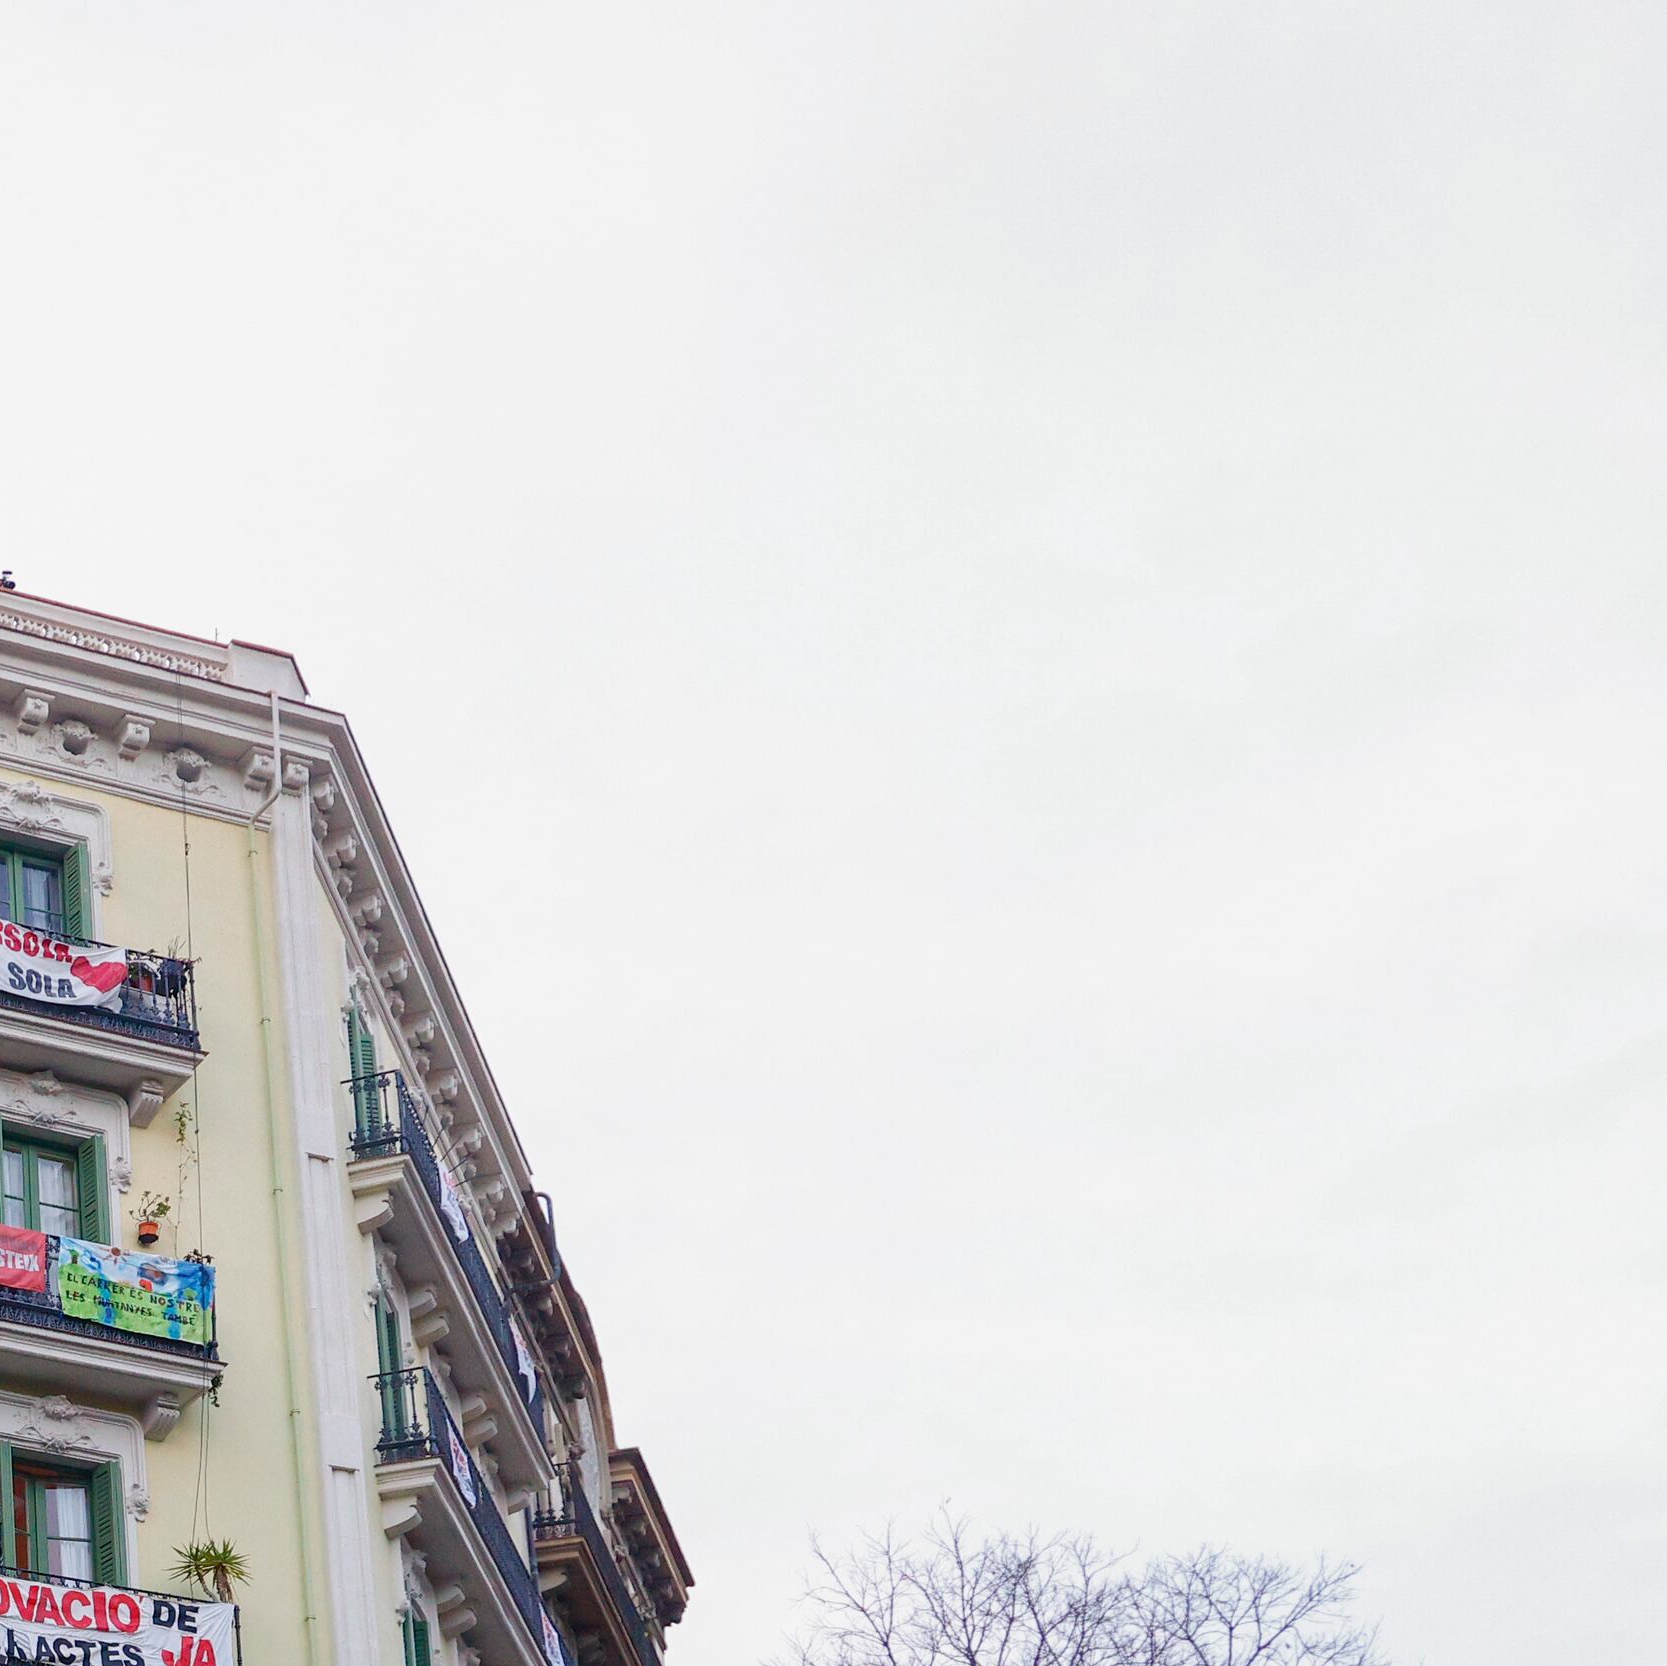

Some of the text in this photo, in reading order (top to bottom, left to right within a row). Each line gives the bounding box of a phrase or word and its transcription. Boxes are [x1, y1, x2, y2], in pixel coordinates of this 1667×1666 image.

[8, 960, 77, 999] SOLA
[66, 1290, 87, 1303] LES
[67, 1272, 79, 1284] EL
[82, 1275, 126, 1297] CARRER
[150, 1294, 201, 1313] NOSTRE
[151, 1599, 199, 1634] DE
